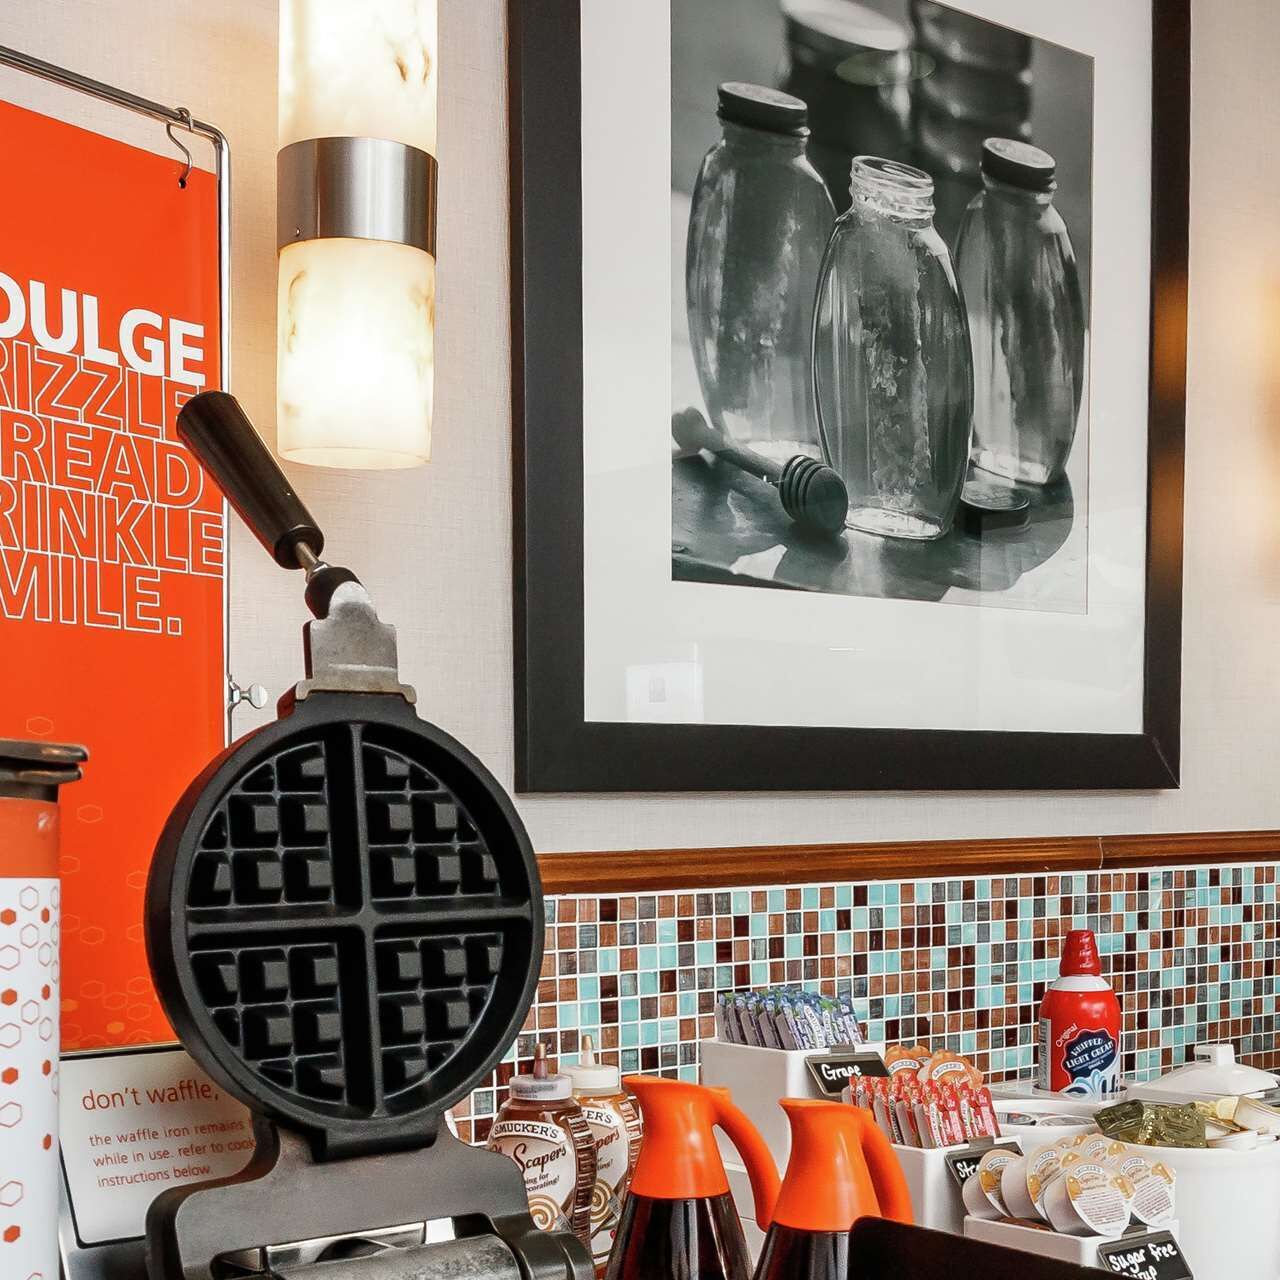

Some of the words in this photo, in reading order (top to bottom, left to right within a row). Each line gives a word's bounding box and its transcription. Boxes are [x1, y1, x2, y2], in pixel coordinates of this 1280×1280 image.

[1065, 1053, 1090, 1068] LIGHT
[82, 1087, 142, 1111] don't
[146, 1079, 219, 1105] waffle,
[89, 1134, 112, 1147] the
[116, 1126, 159, 1143] waffle
[164, 1126, 190, 1138] iron
[194, 1119, 245, 1135] remains
[493, 1122, 559, 1139] SMUCKER'S
[93, 1154, 129, 1167] while
[133, 1151, 145, 1162] in
[149, 1150, 174, 1161] use.
[178, 1143, 207, 1157] refer
[209, 1142, 224, 1153] to
[513, 1142, 567, 1175] Scapers
[97, 1169, 170, 1188] instructions
[173, 1164, 212, 1178] below.
[539, 1172, 549, 1181] for
